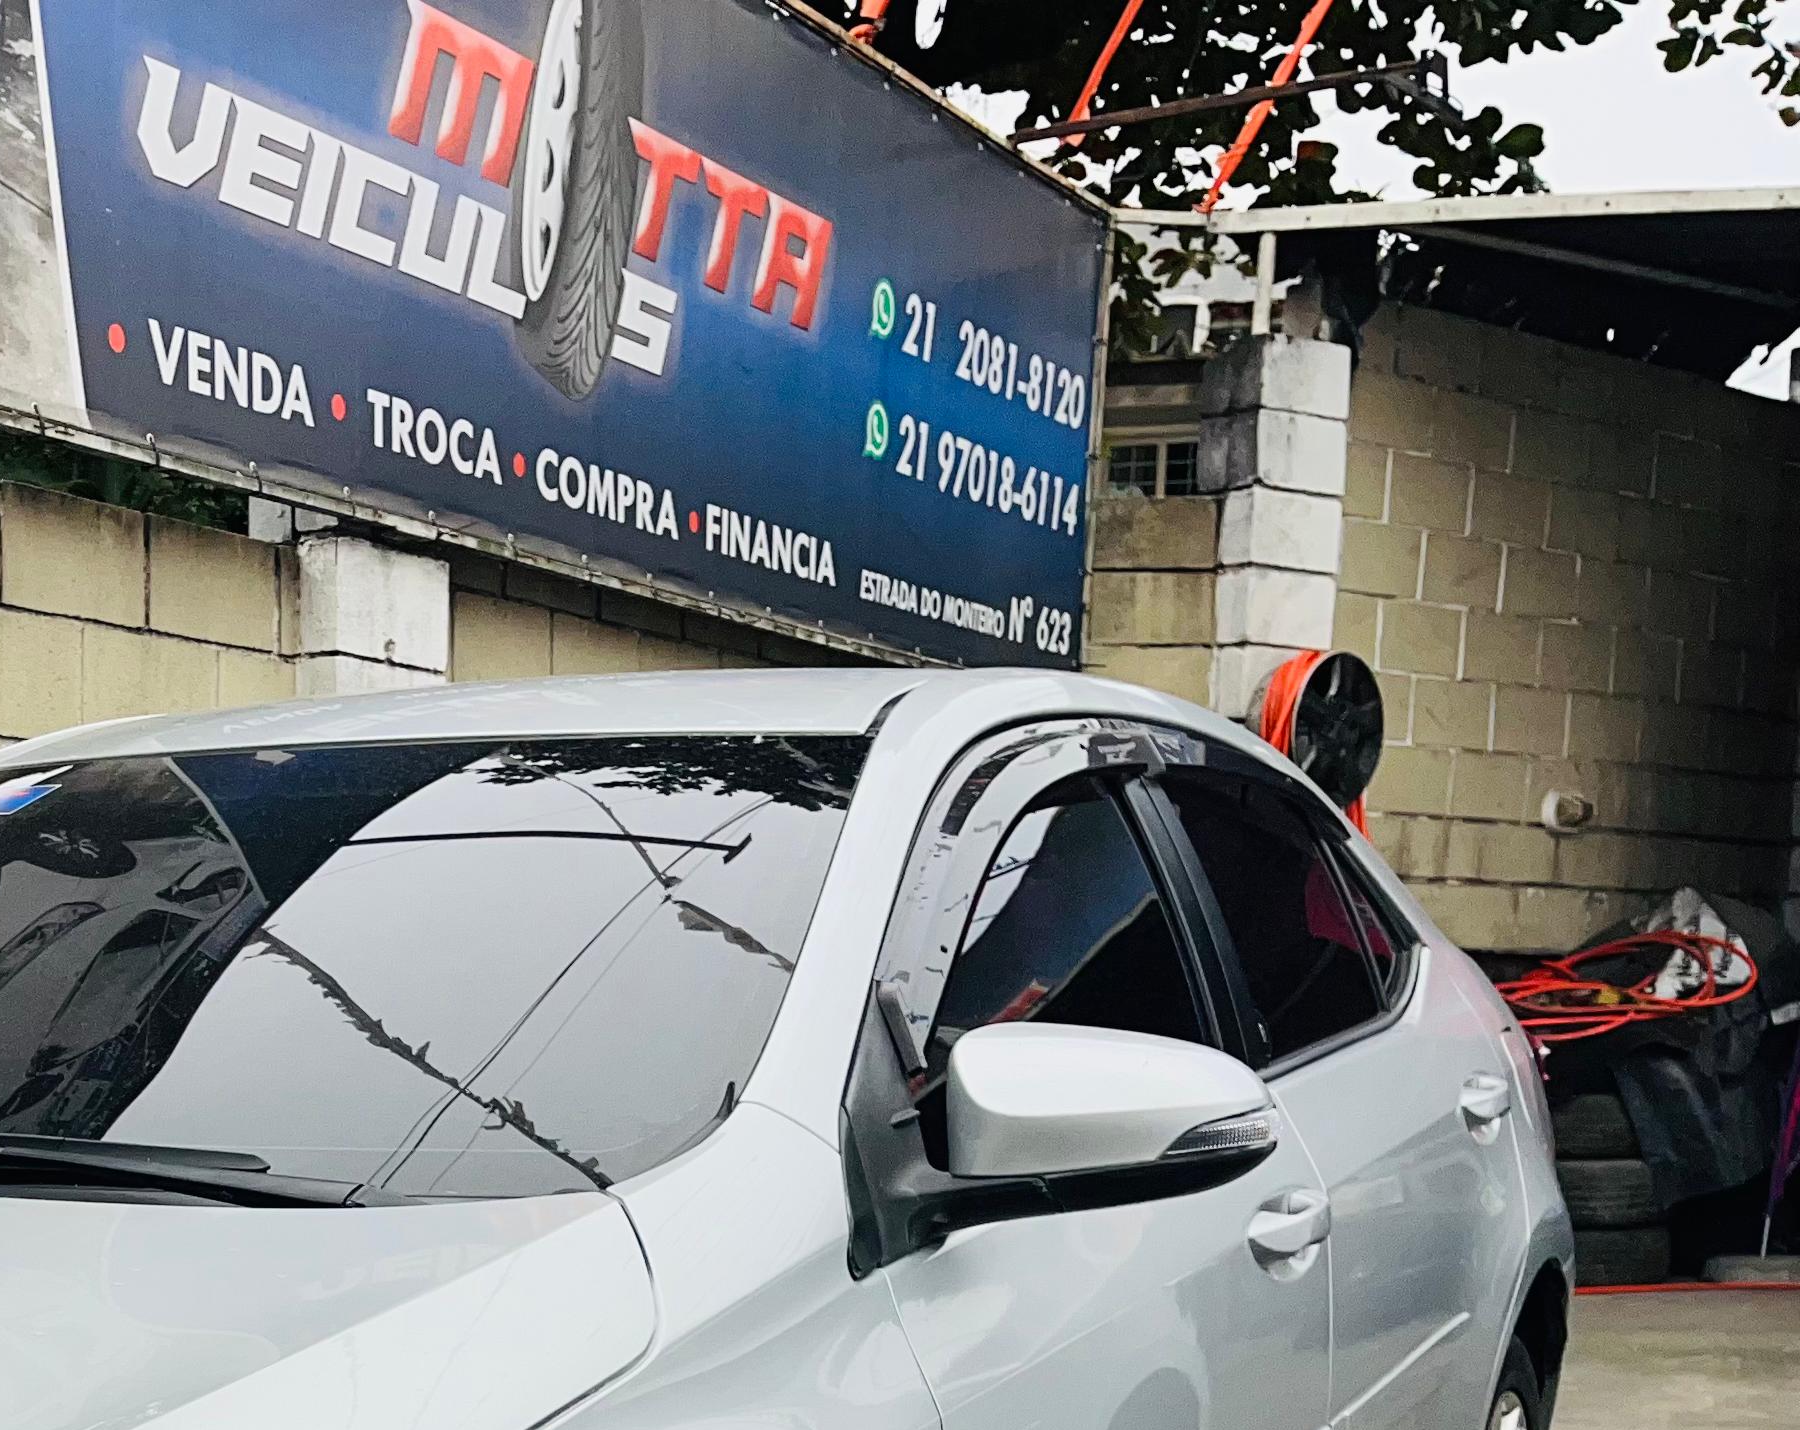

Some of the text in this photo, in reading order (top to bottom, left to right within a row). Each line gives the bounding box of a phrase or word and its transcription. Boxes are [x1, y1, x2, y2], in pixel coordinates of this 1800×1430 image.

[900, 292, 1086, 430] 21 2081-8120
[148, 318, 836, 587] VENDA TROCA COMPRA FINANCIA
[895, 413, 1080, 537] 21 97018-6114
[859, 568, 919, 615] ESTRADA
[919, 586, 942, 620] DO
[1036, 605, 1073, 656] 623
